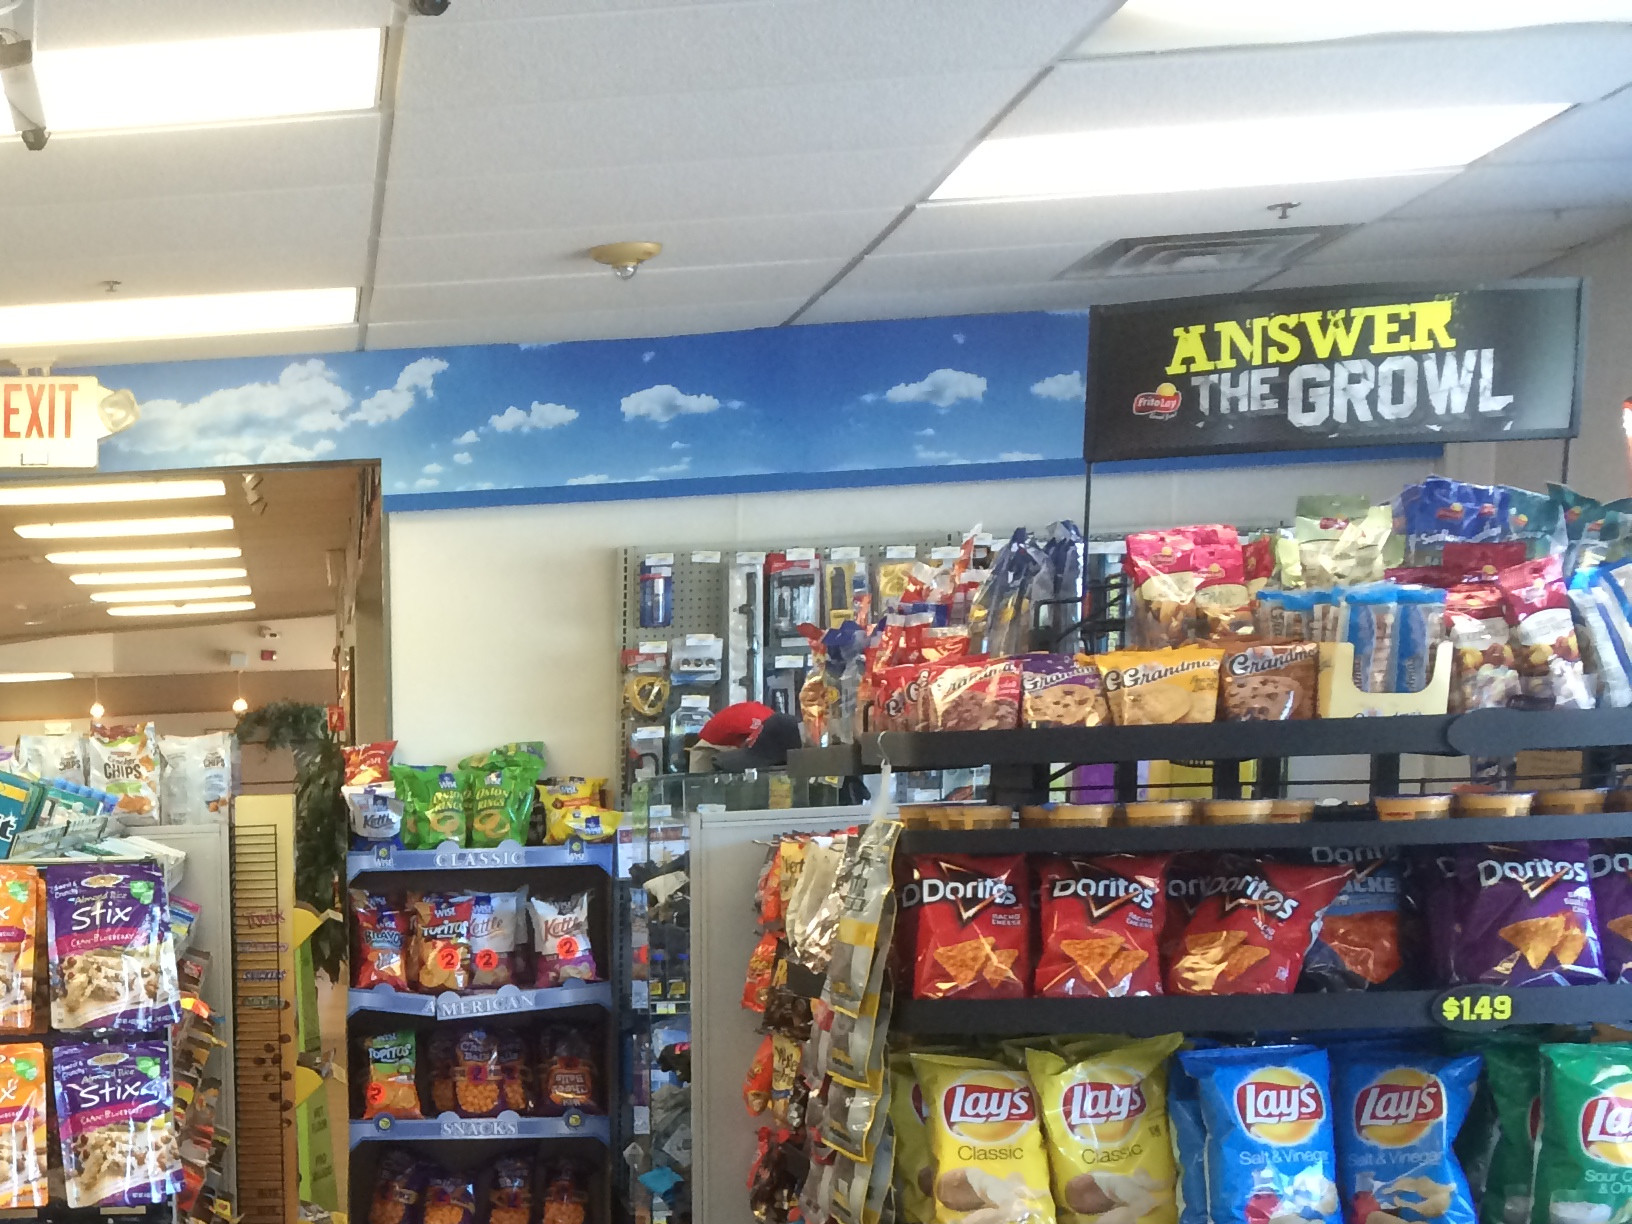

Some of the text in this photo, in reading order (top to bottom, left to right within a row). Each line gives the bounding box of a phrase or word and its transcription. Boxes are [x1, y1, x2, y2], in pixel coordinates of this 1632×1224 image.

[1166, 300, 1457, 374] ANSWER
[1192, 348, 1514, 428] THE GROWL
[3, 383, 79, 438] EXIT
[103, 763, 142, 779] CHIPS
[435, 851, 524, 867] CLASSIC
[1477, 858, 1587, 888] Doritos
[922, 878, 1017, 905] Doritos
[1053, 878, 1154, 909] Doritos
[1209, 874, 1299, 920] Doritos
[1343, 876, 1397, 893] ACKE
[71, 901, 132, 931] Stix
[424, 995, 535, 1018] AMERICAN
[1442, 995, 1512, 1021] $1.49
[79, 1079, 140, 1109] Stix
[951, 1084, 1030, 1124] Lay's
[1070, 1083, 1141, 1124] Lay's
[1246, 1083, 1317, 1124] Lay's
[1360, 1086, 1436, 1126] Lay's
[441, 1121, 517, 1136] SNACKS
[957, 1145, 1024, 1162] Classic
[1081, 1143, 1143, 1165] Classic
[1239, 1150, 1268, 1167] Salt
[1282, 1150, 1328, 1167] Vinega
[1584, 1169, 1618, 1182] Sour
